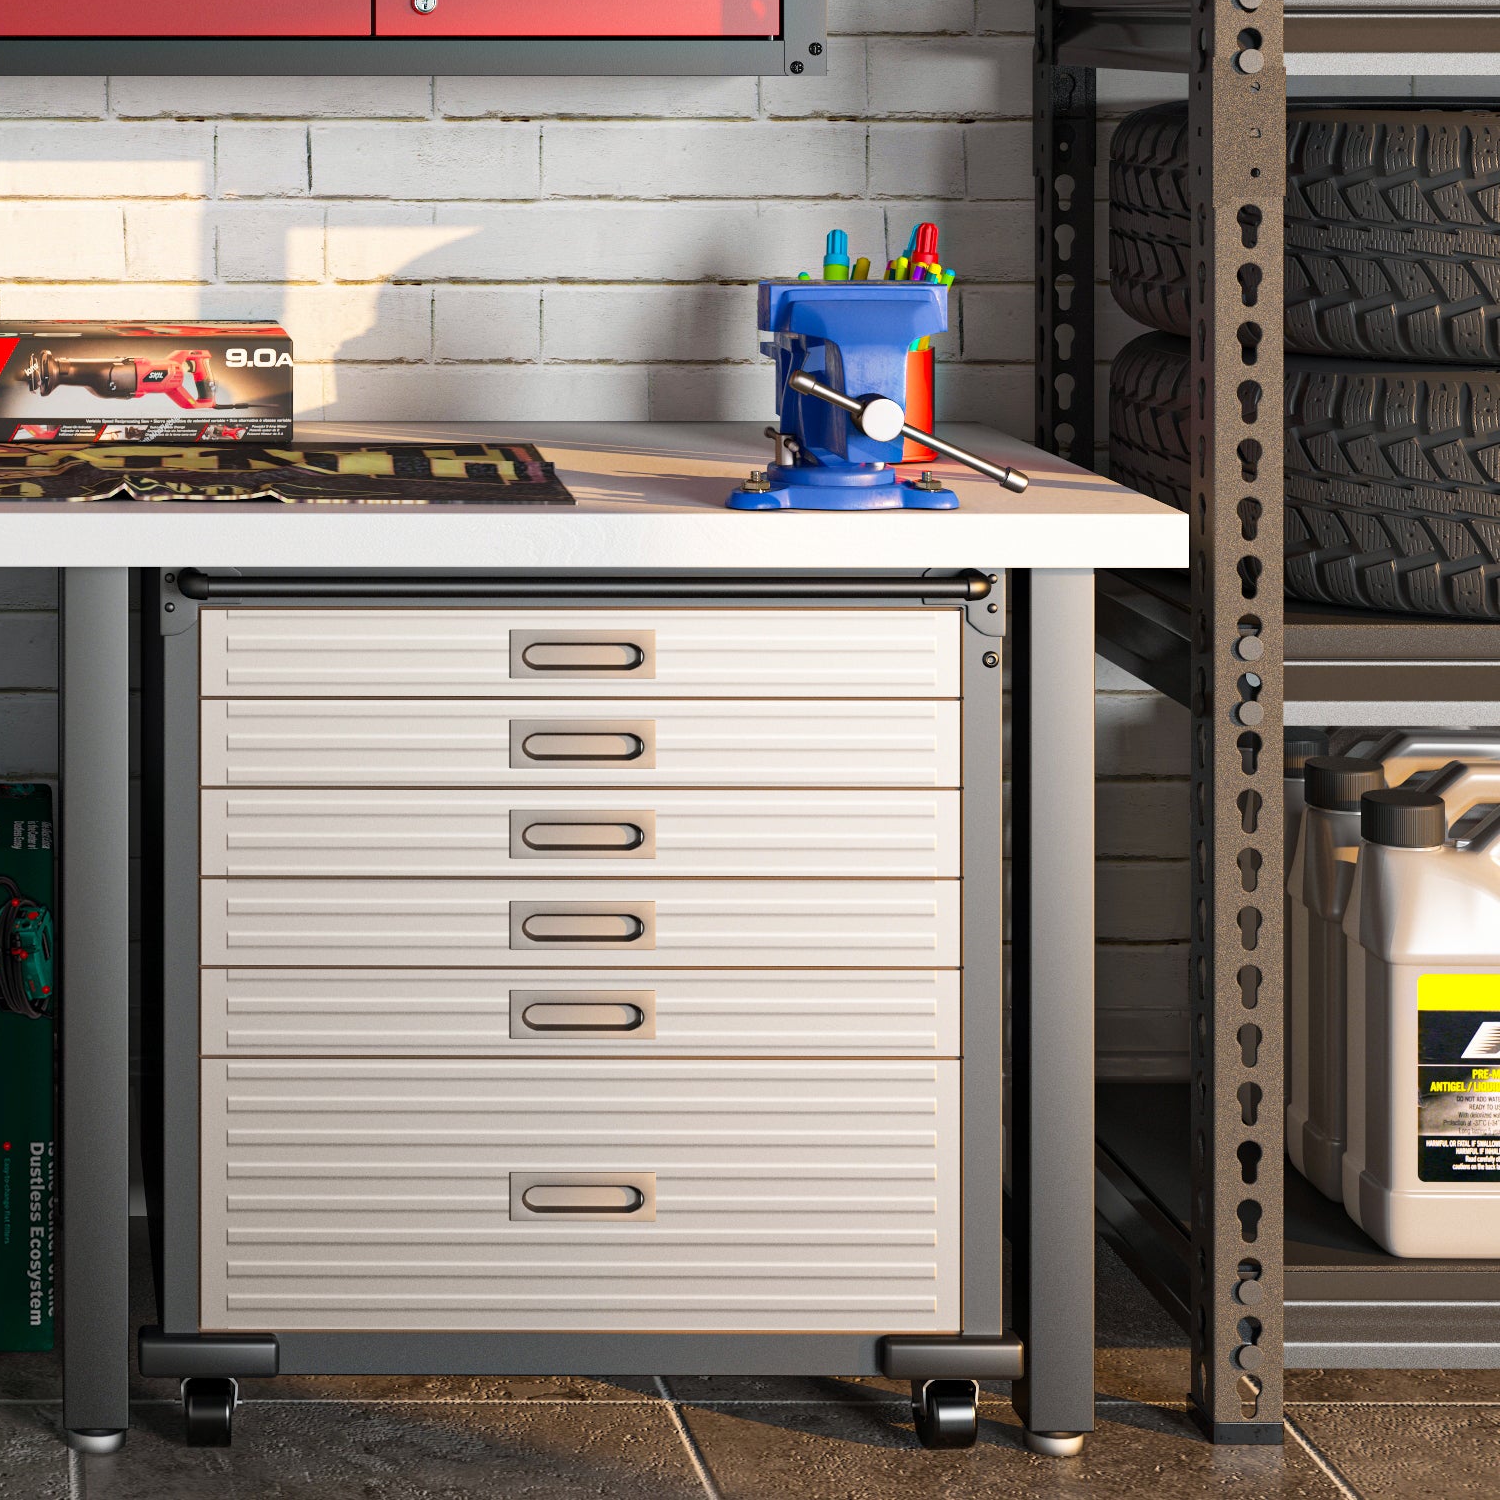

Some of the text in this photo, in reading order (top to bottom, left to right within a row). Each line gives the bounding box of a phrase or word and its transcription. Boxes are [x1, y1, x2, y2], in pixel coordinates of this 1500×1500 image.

[148, 371, 164, 379] SKIL
[27, 1142, 45, 1326] Dustless Ecosystem
